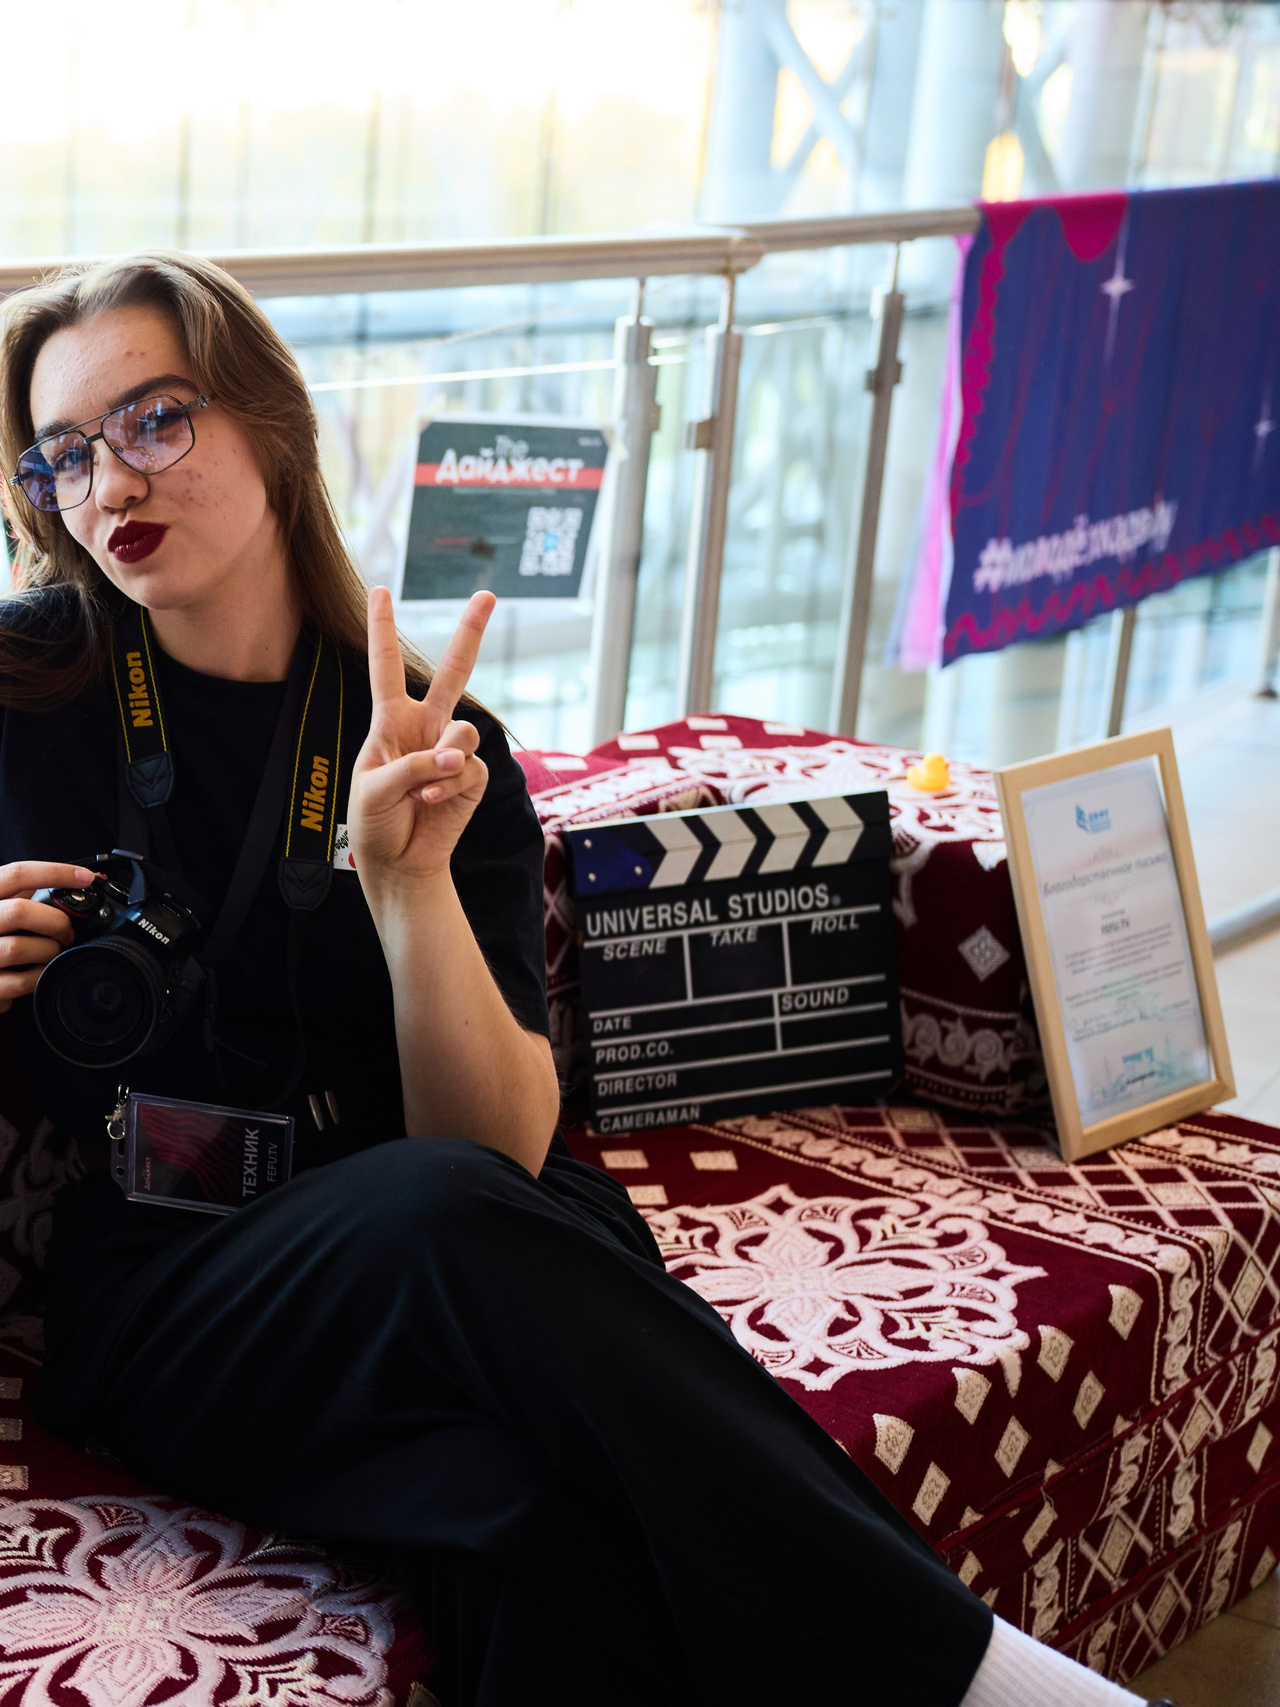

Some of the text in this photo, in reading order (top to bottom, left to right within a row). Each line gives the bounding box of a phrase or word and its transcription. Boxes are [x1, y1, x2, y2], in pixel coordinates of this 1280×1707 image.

[125, 651, 154, 728] Nikon
[300, 755, 330, 832] Nikon
[137, 916, 171, 945] Nikon
[586, 899, 718, 938] UNIVERSAL
[603, 914, 860, 961] SCENE TAKE ROLL
[781, 986, 850, 1012] SOUND
[593, 1015, 632, 1034] DATE
[595, 1040, 674, 1065] PROD.CO.
[598, 1072, 678, 1097] DIRECTOR
[600, 1104, 701, 1134] CAMERAMAN
[242, 1127, 260, 1197] ТЕХНИК
[266, 1142, 280, 1183] FEFU.TV
